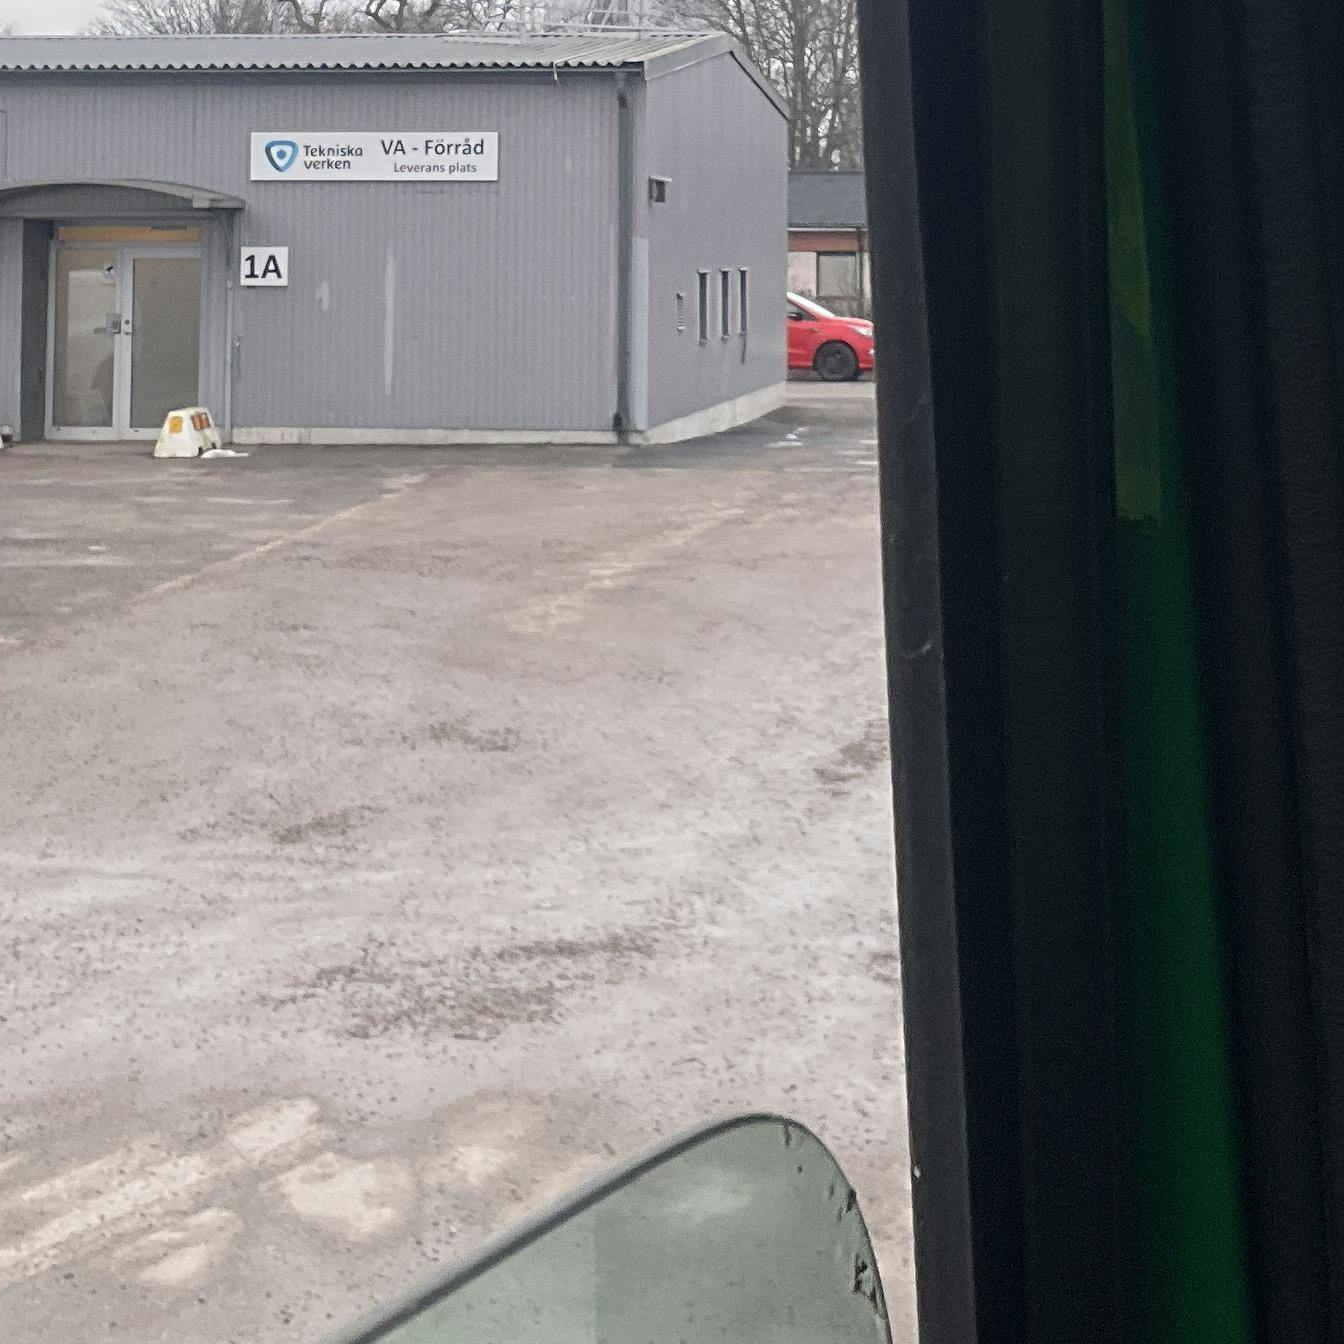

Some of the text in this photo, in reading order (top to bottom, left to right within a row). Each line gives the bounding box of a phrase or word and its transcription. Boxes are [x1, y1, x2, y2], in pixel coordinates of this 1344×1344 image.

[303, 144, 363, 157] Tekniska
[381, 139, 406, 155] VA
[424, 137, 485, 156] Förråd
[303, 158, 351, 170] verken
[393, 162, 477, 175] Leverans plats
[244, 254, 283, 279] 1A
